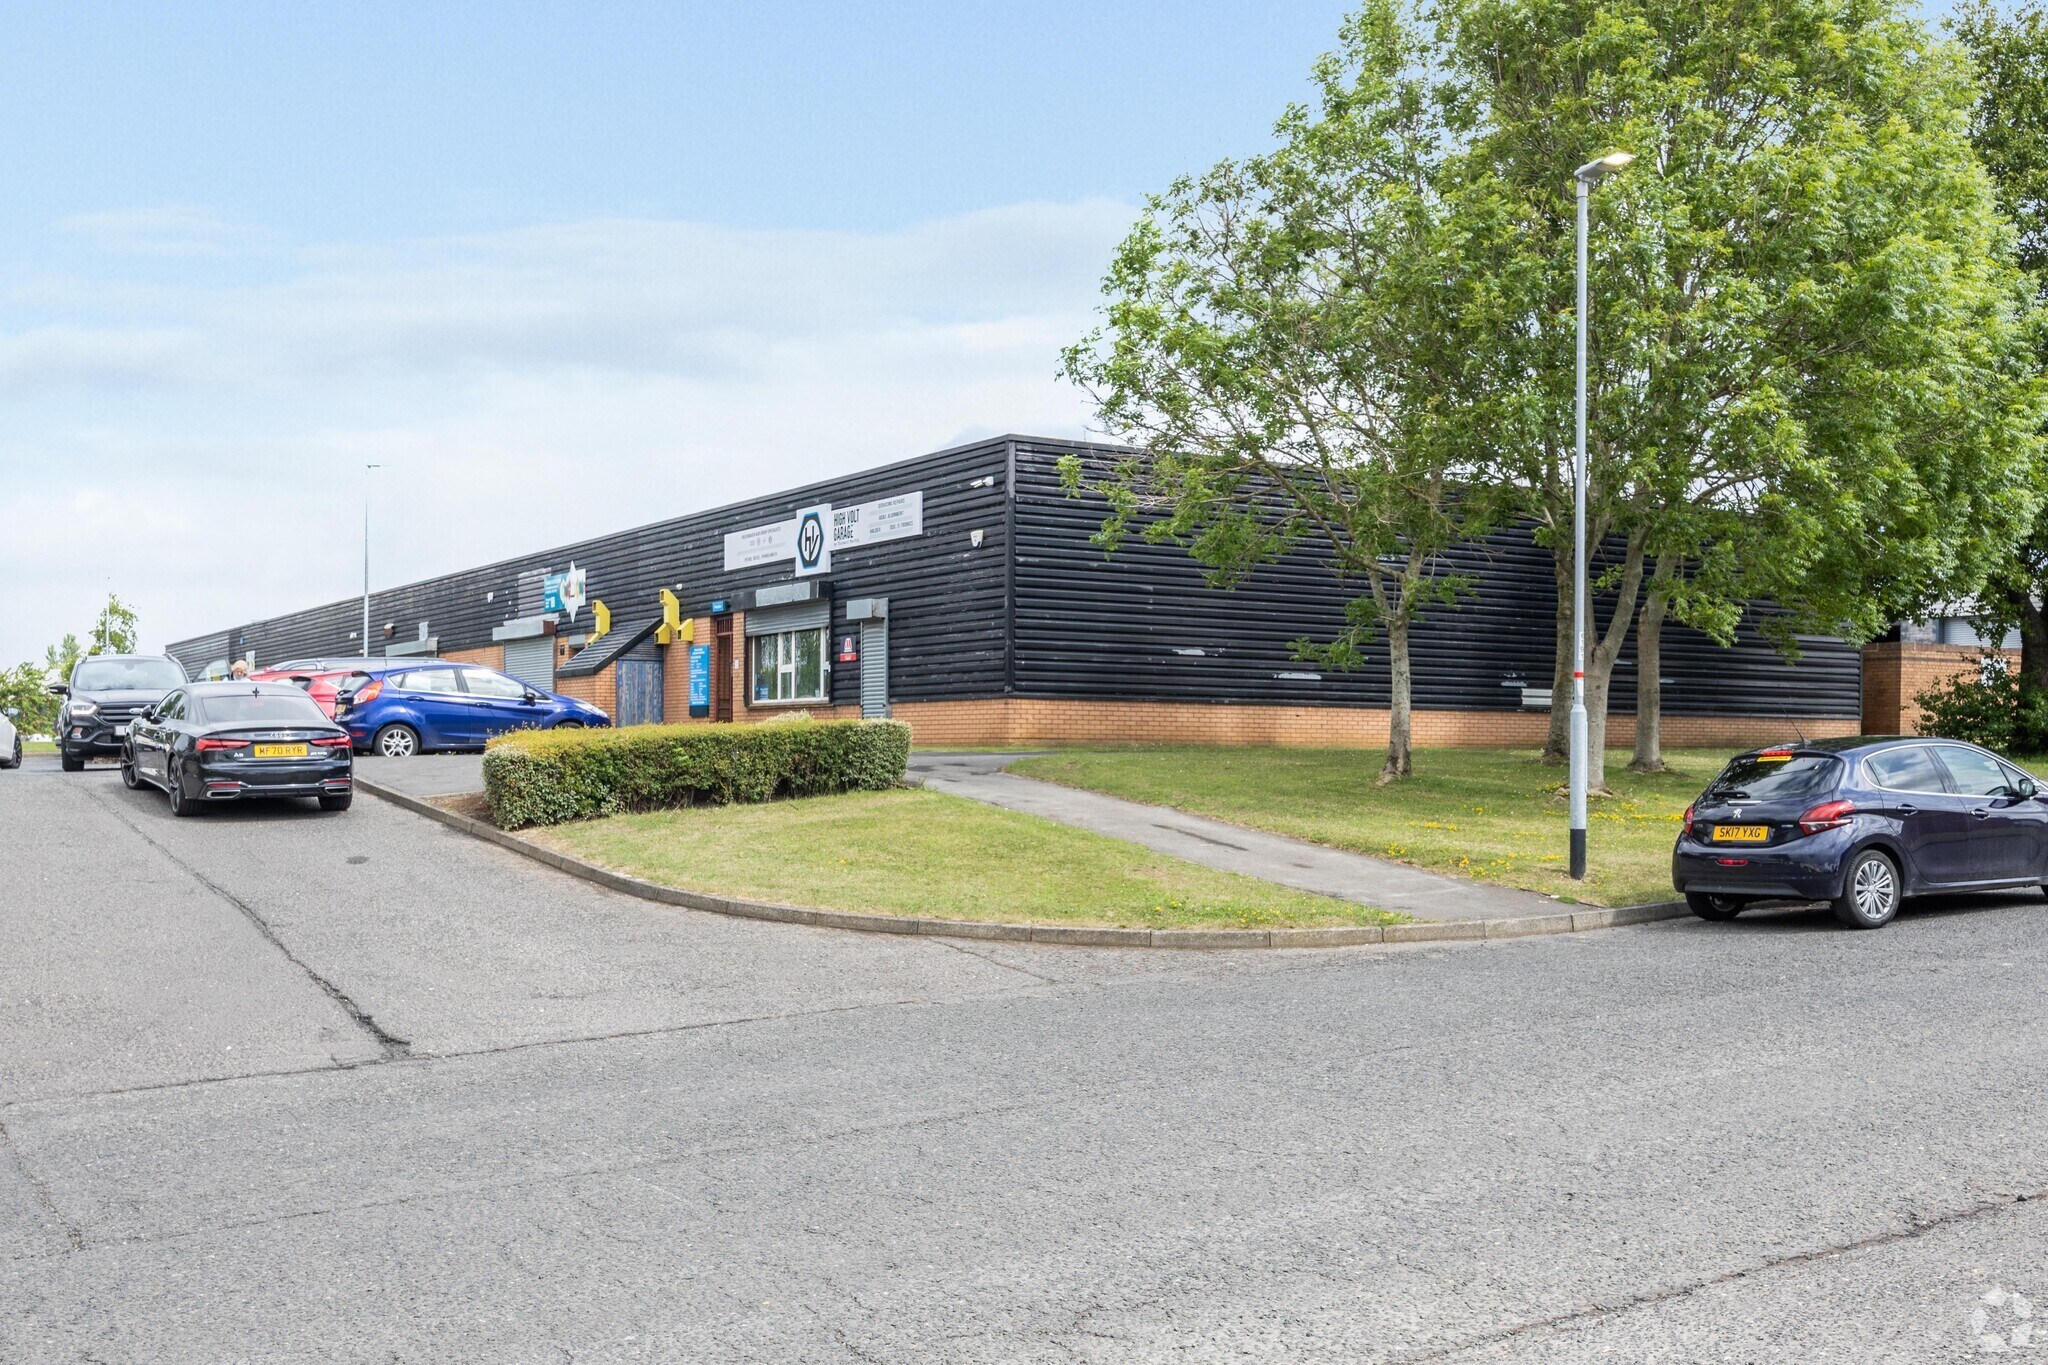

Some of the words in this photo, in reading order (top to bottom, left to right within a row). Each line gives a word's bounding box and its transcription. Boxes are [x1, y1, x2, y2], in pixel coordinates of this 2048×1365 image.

[834, 512, 846, 527] HIGH
[846, 508, 860, 524] VOLT
[834, 525, 853, 541] GARAGE
[285, 745, 303, 755] RYR
[1719, 826, 1740, 838] SK17
[1742, 826, 1761, 838] YXG
